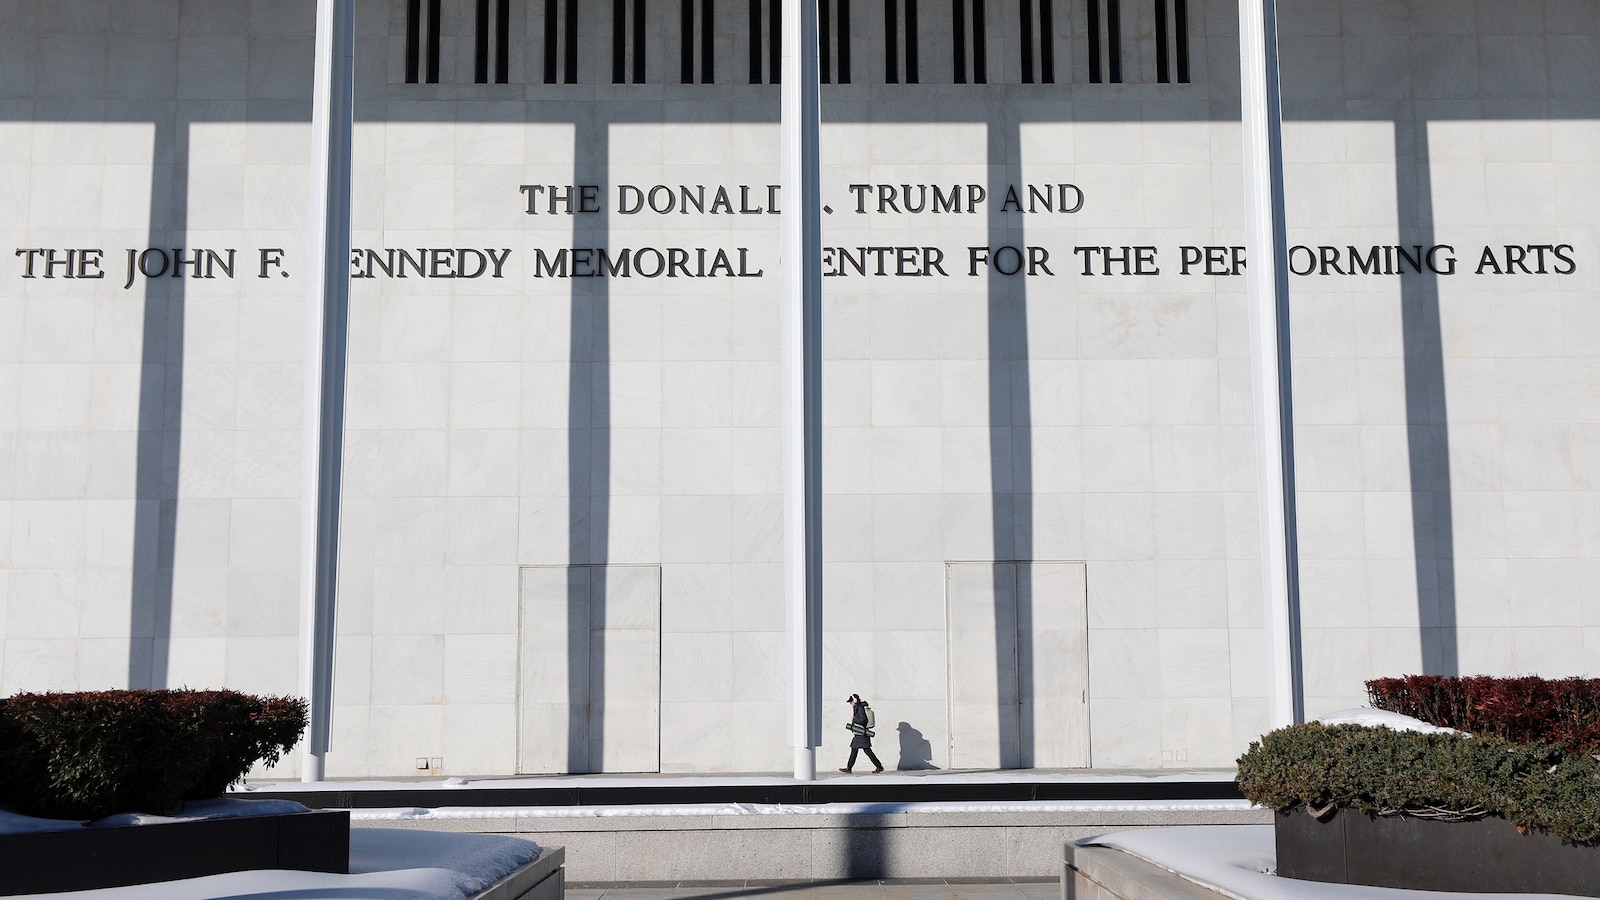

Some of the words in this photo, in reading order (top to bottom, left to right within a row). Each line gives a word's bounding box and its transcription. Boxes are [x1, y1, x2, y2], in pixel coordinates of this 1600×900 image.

[519, 184, 601, 215] THE
[849, 184, 987, 214] TRUMP
[1000, 184, 1085, 214] AND
[15, 247, 105, 279] THE
[124, 247, 237, 290] JOHN
[257, 248, 290, 278] F.
[351, 248, 512, 279] ENNEDY
[533, 247, 764, 278] MEMORIAL
[780, 246, 950, 277] ENTER
[967, 245, 1055, 276] FOR
[1073, 245, 1160, 276] THE
[1179, 244, 1458, 276] PERORMING
[1474, 244, 1577, 276] ARTS
